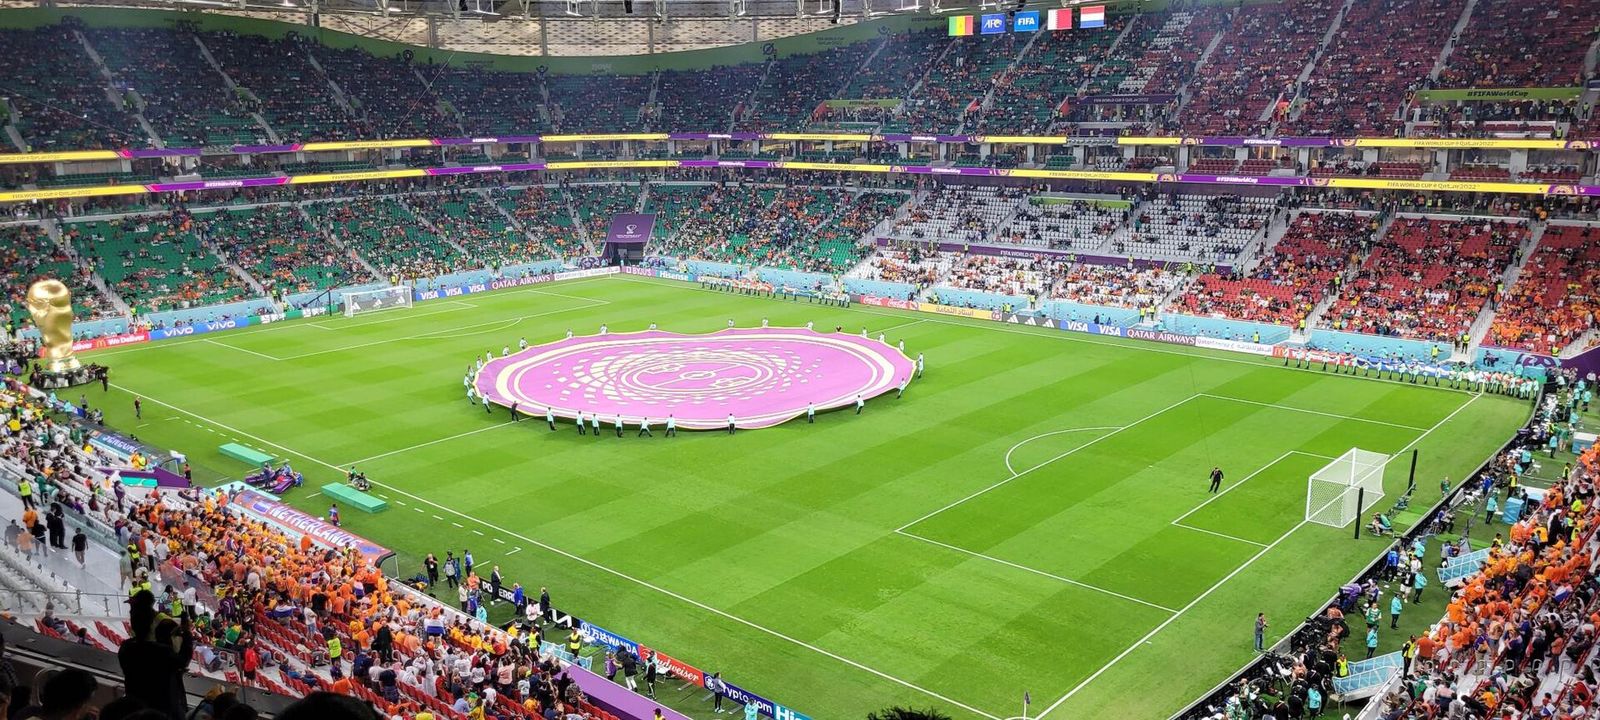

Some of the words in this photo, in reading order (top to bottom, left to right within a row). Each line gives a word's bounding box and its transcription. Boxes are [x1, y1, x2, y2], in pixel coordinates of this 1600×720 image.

[1017, 17, 1035, 25] FIFA
[1467, 90, 1529, 98] #FIFAWorldCup
[491, 278, 518, 290] QATAR
[519, 275, 551, 285] AIRWAYS
[445, 287, 463, 297] VISA
[468, 284, 486, 293] VISA
[420, 290, 439, 300] VISA
[207, 320, 236, 331] vivo
[1066, 320, 1089, 332] VISA
[1098, 325, 1121, 336] VISA
[164, 326, 194, 337] vivo
[1126, 328, 1156, 340] QATAR
[1158, 333, 1196, 345] AIRWAYS
[72, 342, 93, 351] eliver
[608, 636, 638, 655] WANDA
